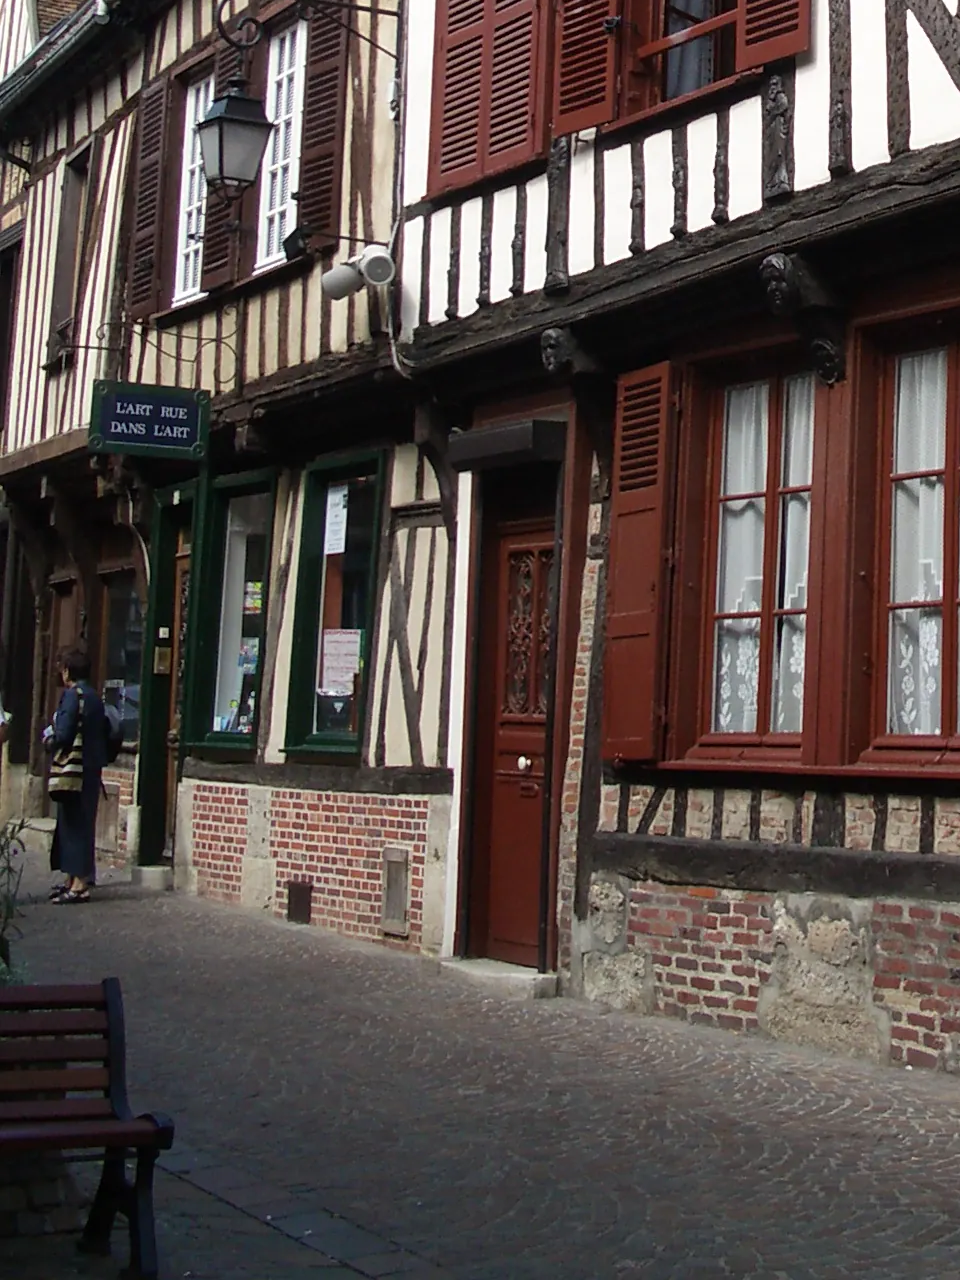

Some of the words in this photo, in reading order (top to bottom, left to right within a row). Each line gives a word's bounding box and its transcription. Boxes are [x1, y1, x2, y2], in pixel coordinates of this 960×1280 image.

[116, 402, 153, 416] L'ART
[160, 406, 188, 419] RUE
[111, 421, 146, 435] DANS
[154, 424, 190, 439] L'ART
